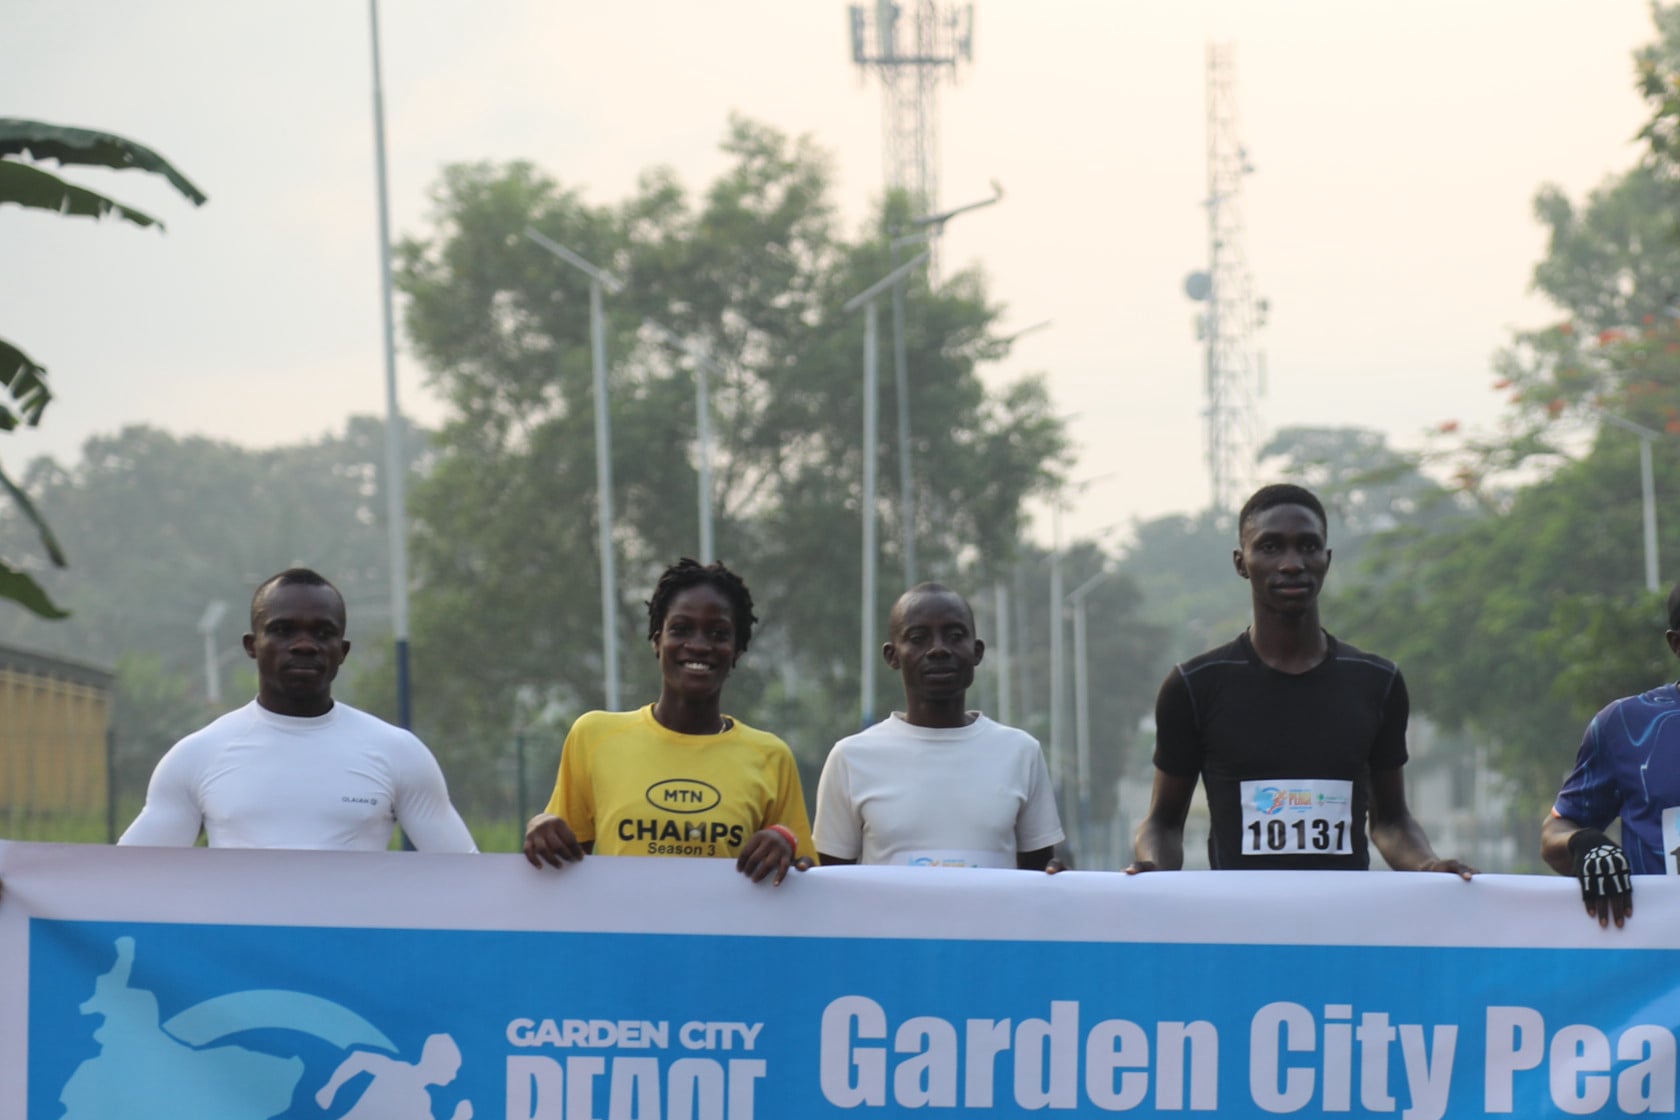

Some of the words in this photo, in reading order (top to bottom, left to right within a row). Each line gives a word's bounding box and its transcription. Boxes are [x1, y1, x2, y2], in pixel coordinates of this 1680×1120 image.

[664, 789, 703, 803] MTN
[618, 819, 744, 847] CHAMPS
[1248, 818, 1346, 851] 10131
[647, 842, 702, 855] Season
[708, 844, 716, 856] 3
[506, 1018, 668, 1049] GARDEN
[679, 1021, 764, 1050] CITY
[820, 995, 1219, 1110] Garden
